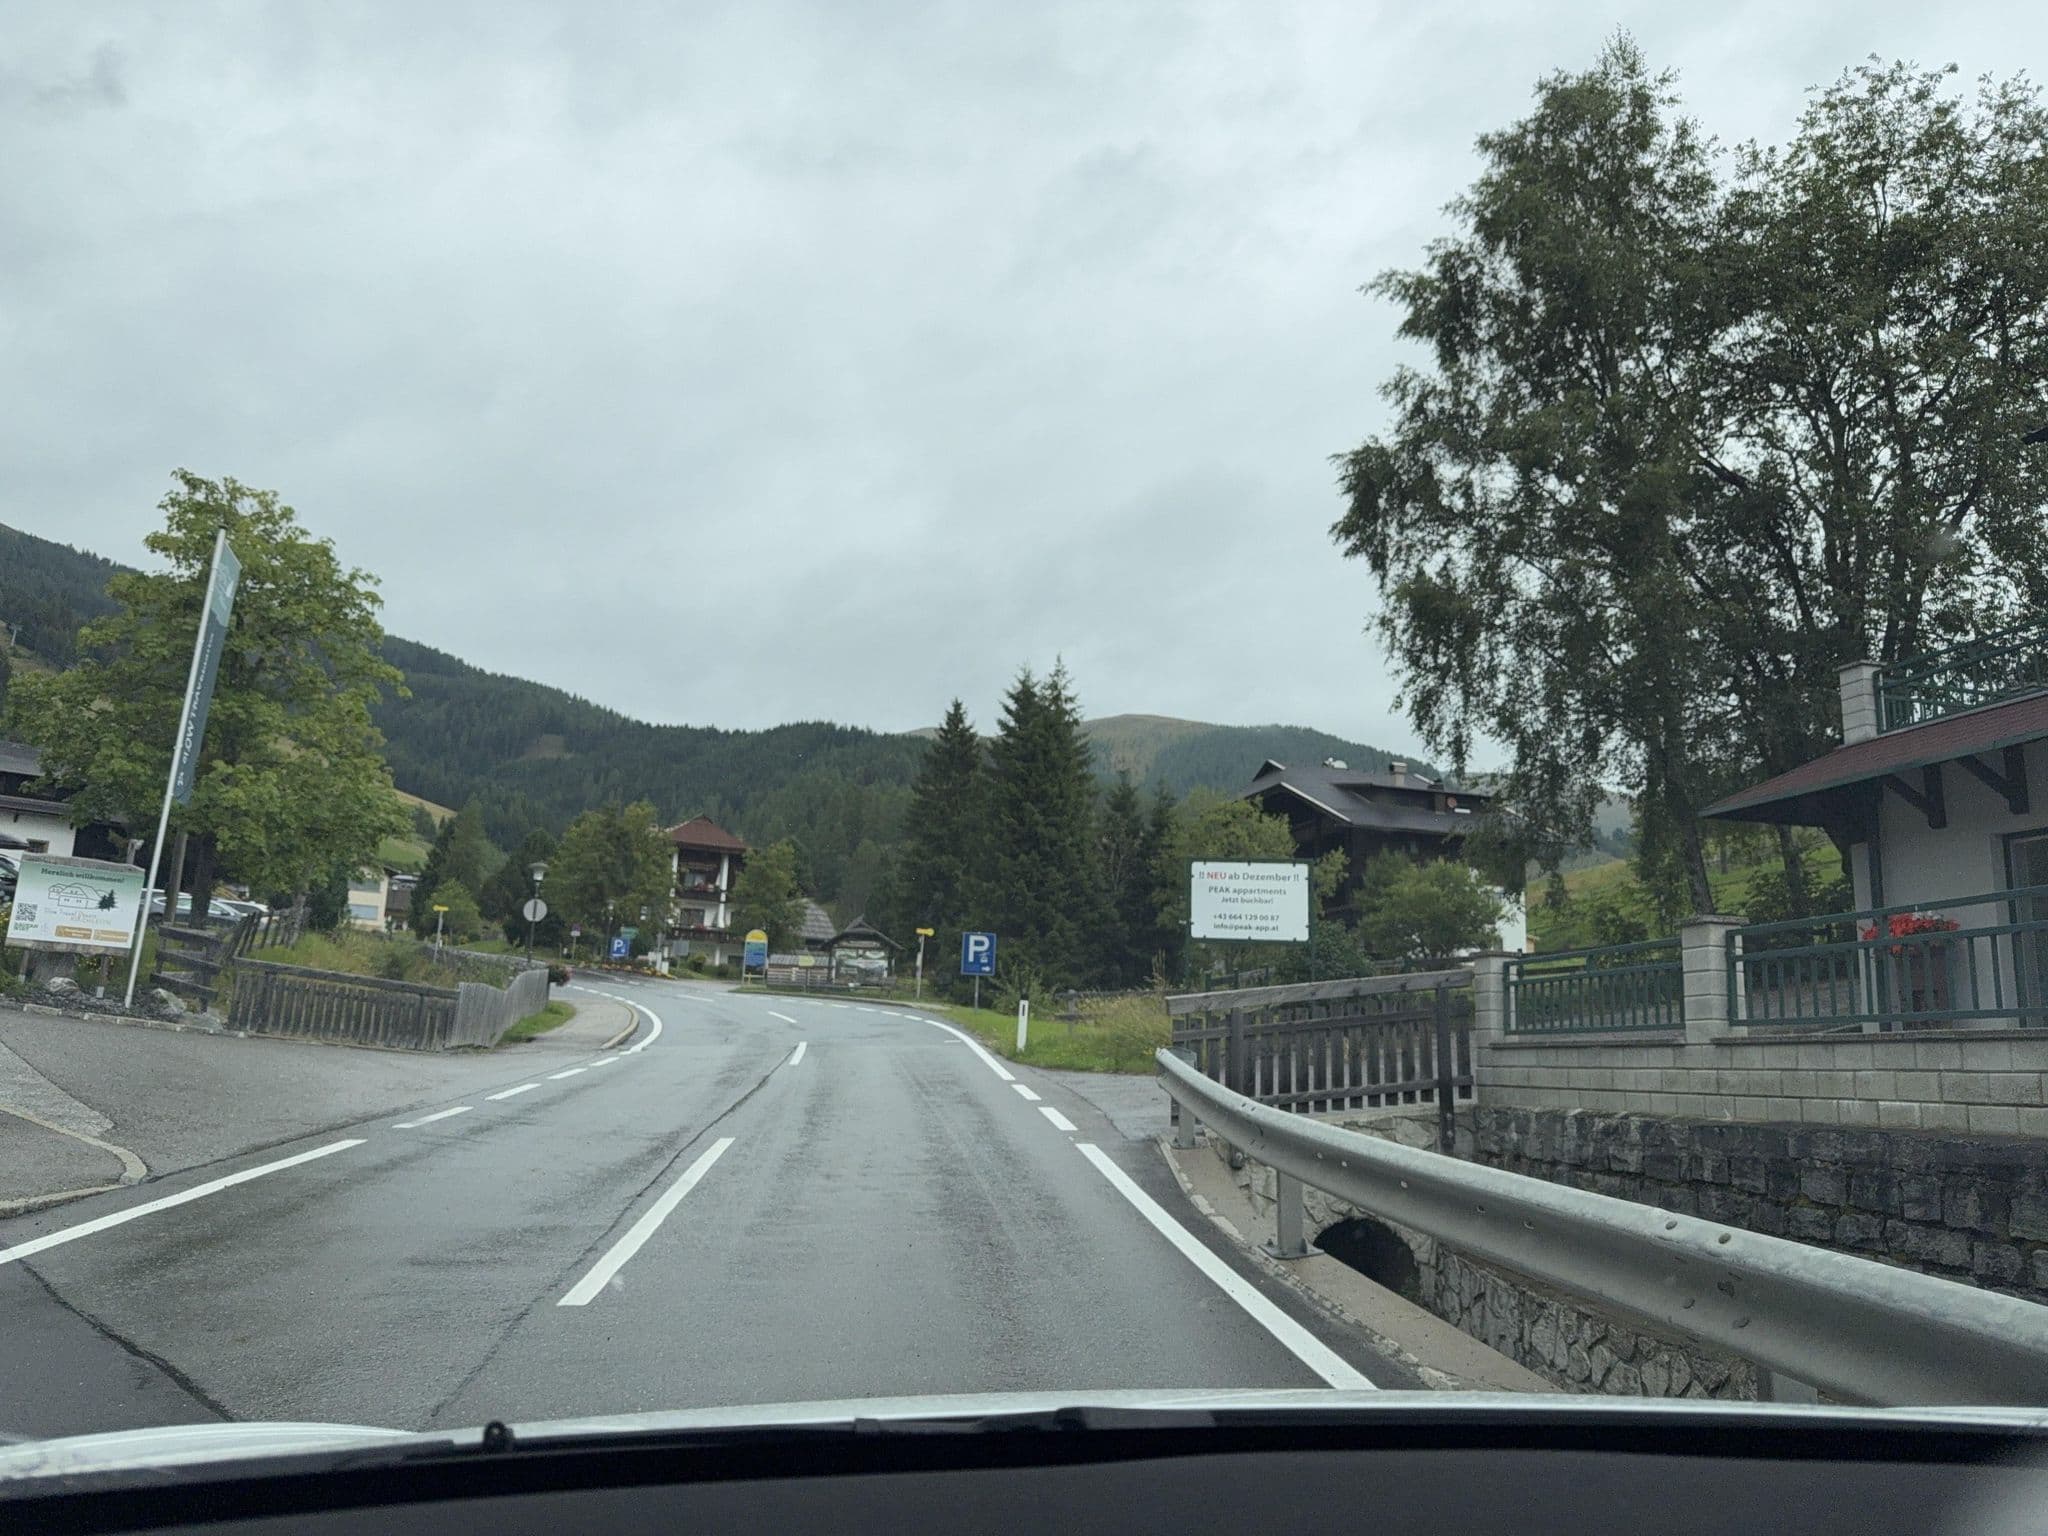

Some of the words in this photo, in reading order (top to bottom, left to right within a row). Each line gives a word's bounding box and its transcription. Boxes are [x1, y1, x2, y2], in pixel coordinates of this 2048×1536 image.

[1206, 871, 1227, 880] NEU
[1228, 872, 1240, 880] ab
[1242, 872, 1291, 881] Dezember
[1208, 885, 1231, 893] PEAK
[1232, 887, 1287, 895] appartments
[613, 938, 624, 952] P
[968, 935, 990, 963] P
